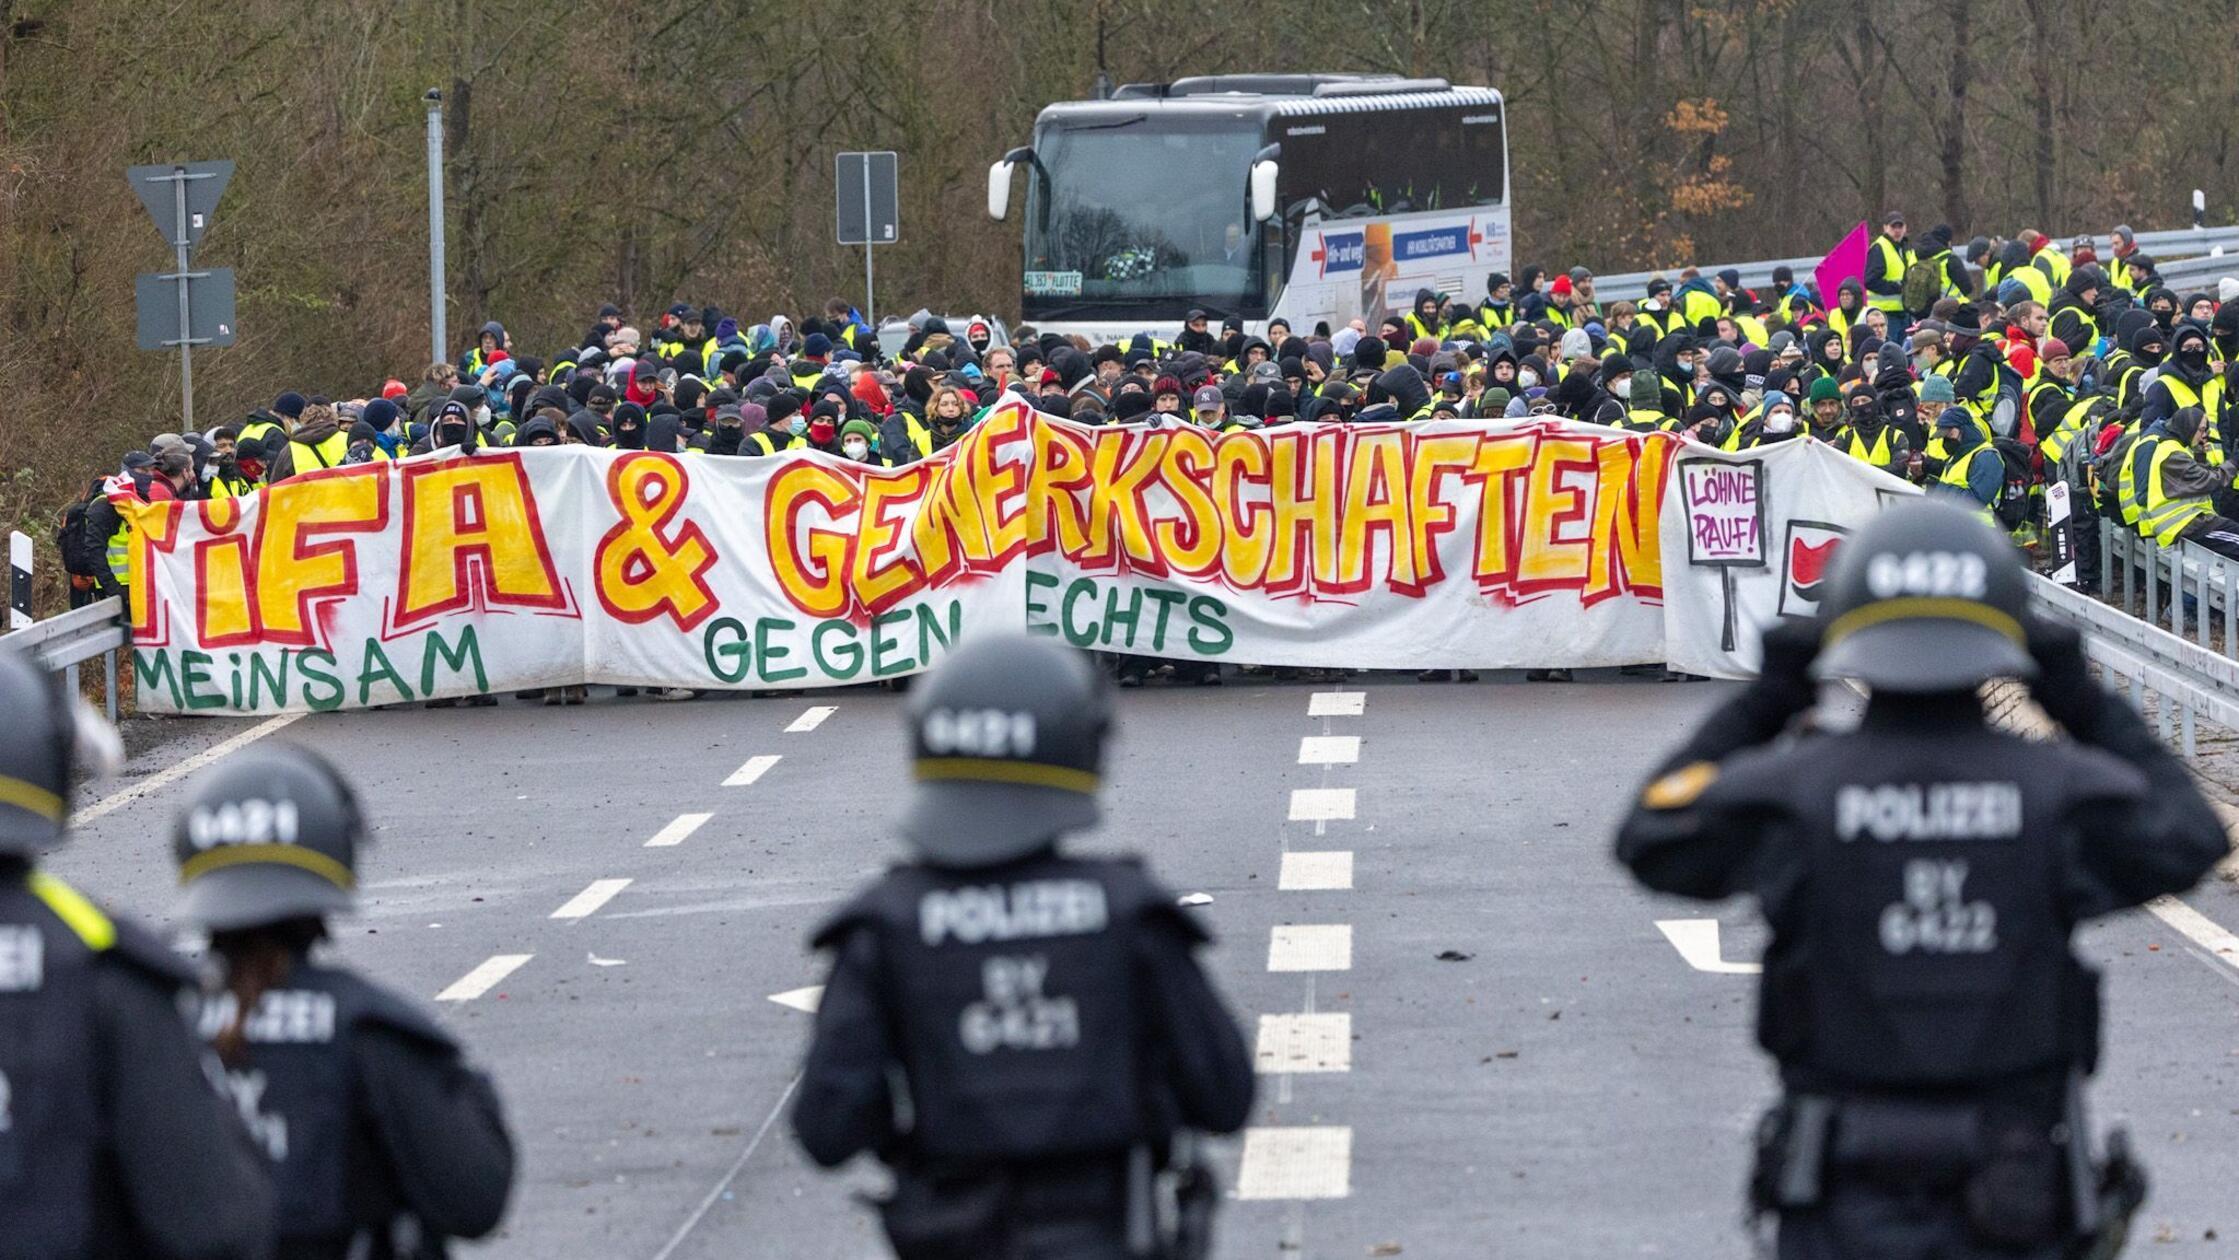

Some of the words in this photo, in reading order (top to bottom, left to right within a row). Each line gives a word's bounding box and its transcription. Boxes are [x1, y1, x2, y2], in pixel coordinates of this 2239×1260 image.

[594, 452, 720, 633] &
[764, 397, 1682, 619] GEWERKSCHAFTEN
[1688, 467, 1756, 507] LÖHNE
[1693, 514, 1757, 554] RAUF!
[704, 599, 961, 683] GEGEN
[1835, 780, 2023, 842] POLIZEI
[919, 879, 1109, 945] POLIZEI
[1904, 859, 1969, 904] BY
